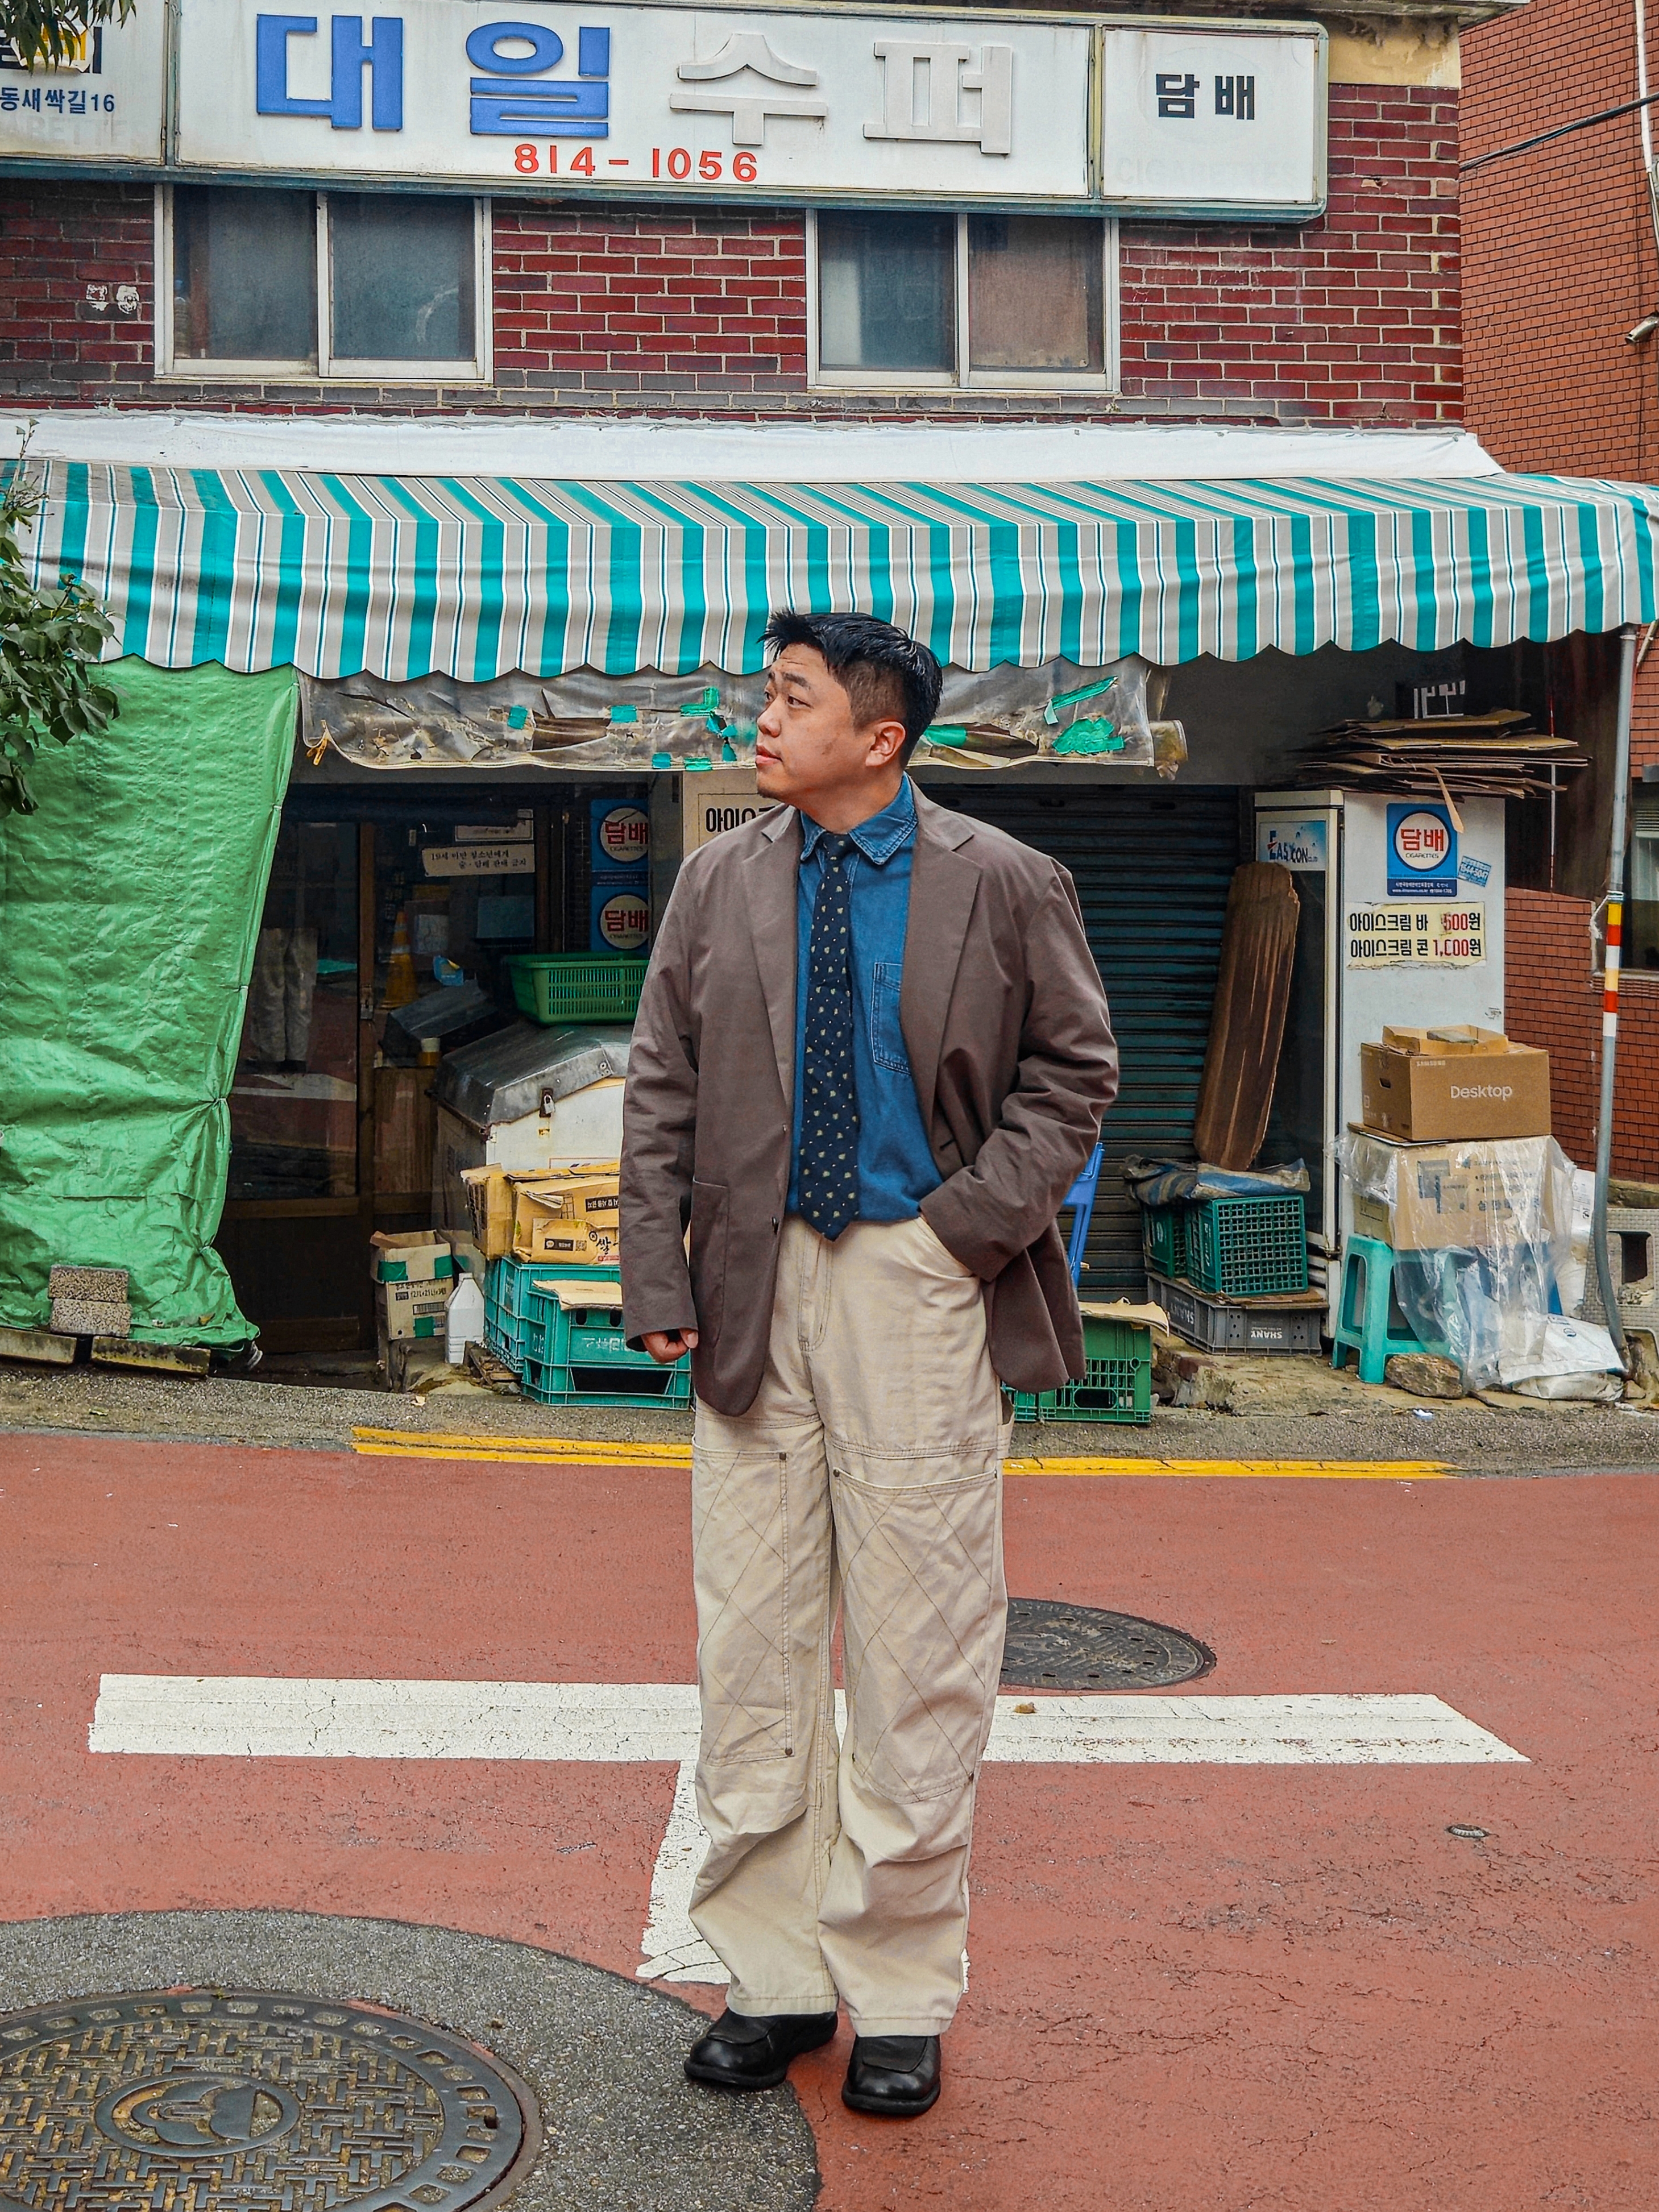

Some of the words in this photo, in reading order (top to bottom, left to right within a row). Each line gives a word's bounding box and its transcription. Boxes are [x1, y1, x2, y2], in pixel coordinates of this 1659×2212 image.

[1156, 73, 1255, 121] 담배
[514, 143, 757, 182] 814-1056
[605, 822, 649, 844] 담배
[1400, 828, 1444, 852] 담배
[605, 910, 649, 932] 담배
[1350, 912, 1412, 931] 아이스크림
[1416, 914, 1428, 931] 바
[1351, 939, 1412, 957] 아이스크림
[1417, 939, 1428, 956] 콘
[1450, 1085, 1512, 1101] Desktop
[1251, 1330, 1283, 1339] SHANY
